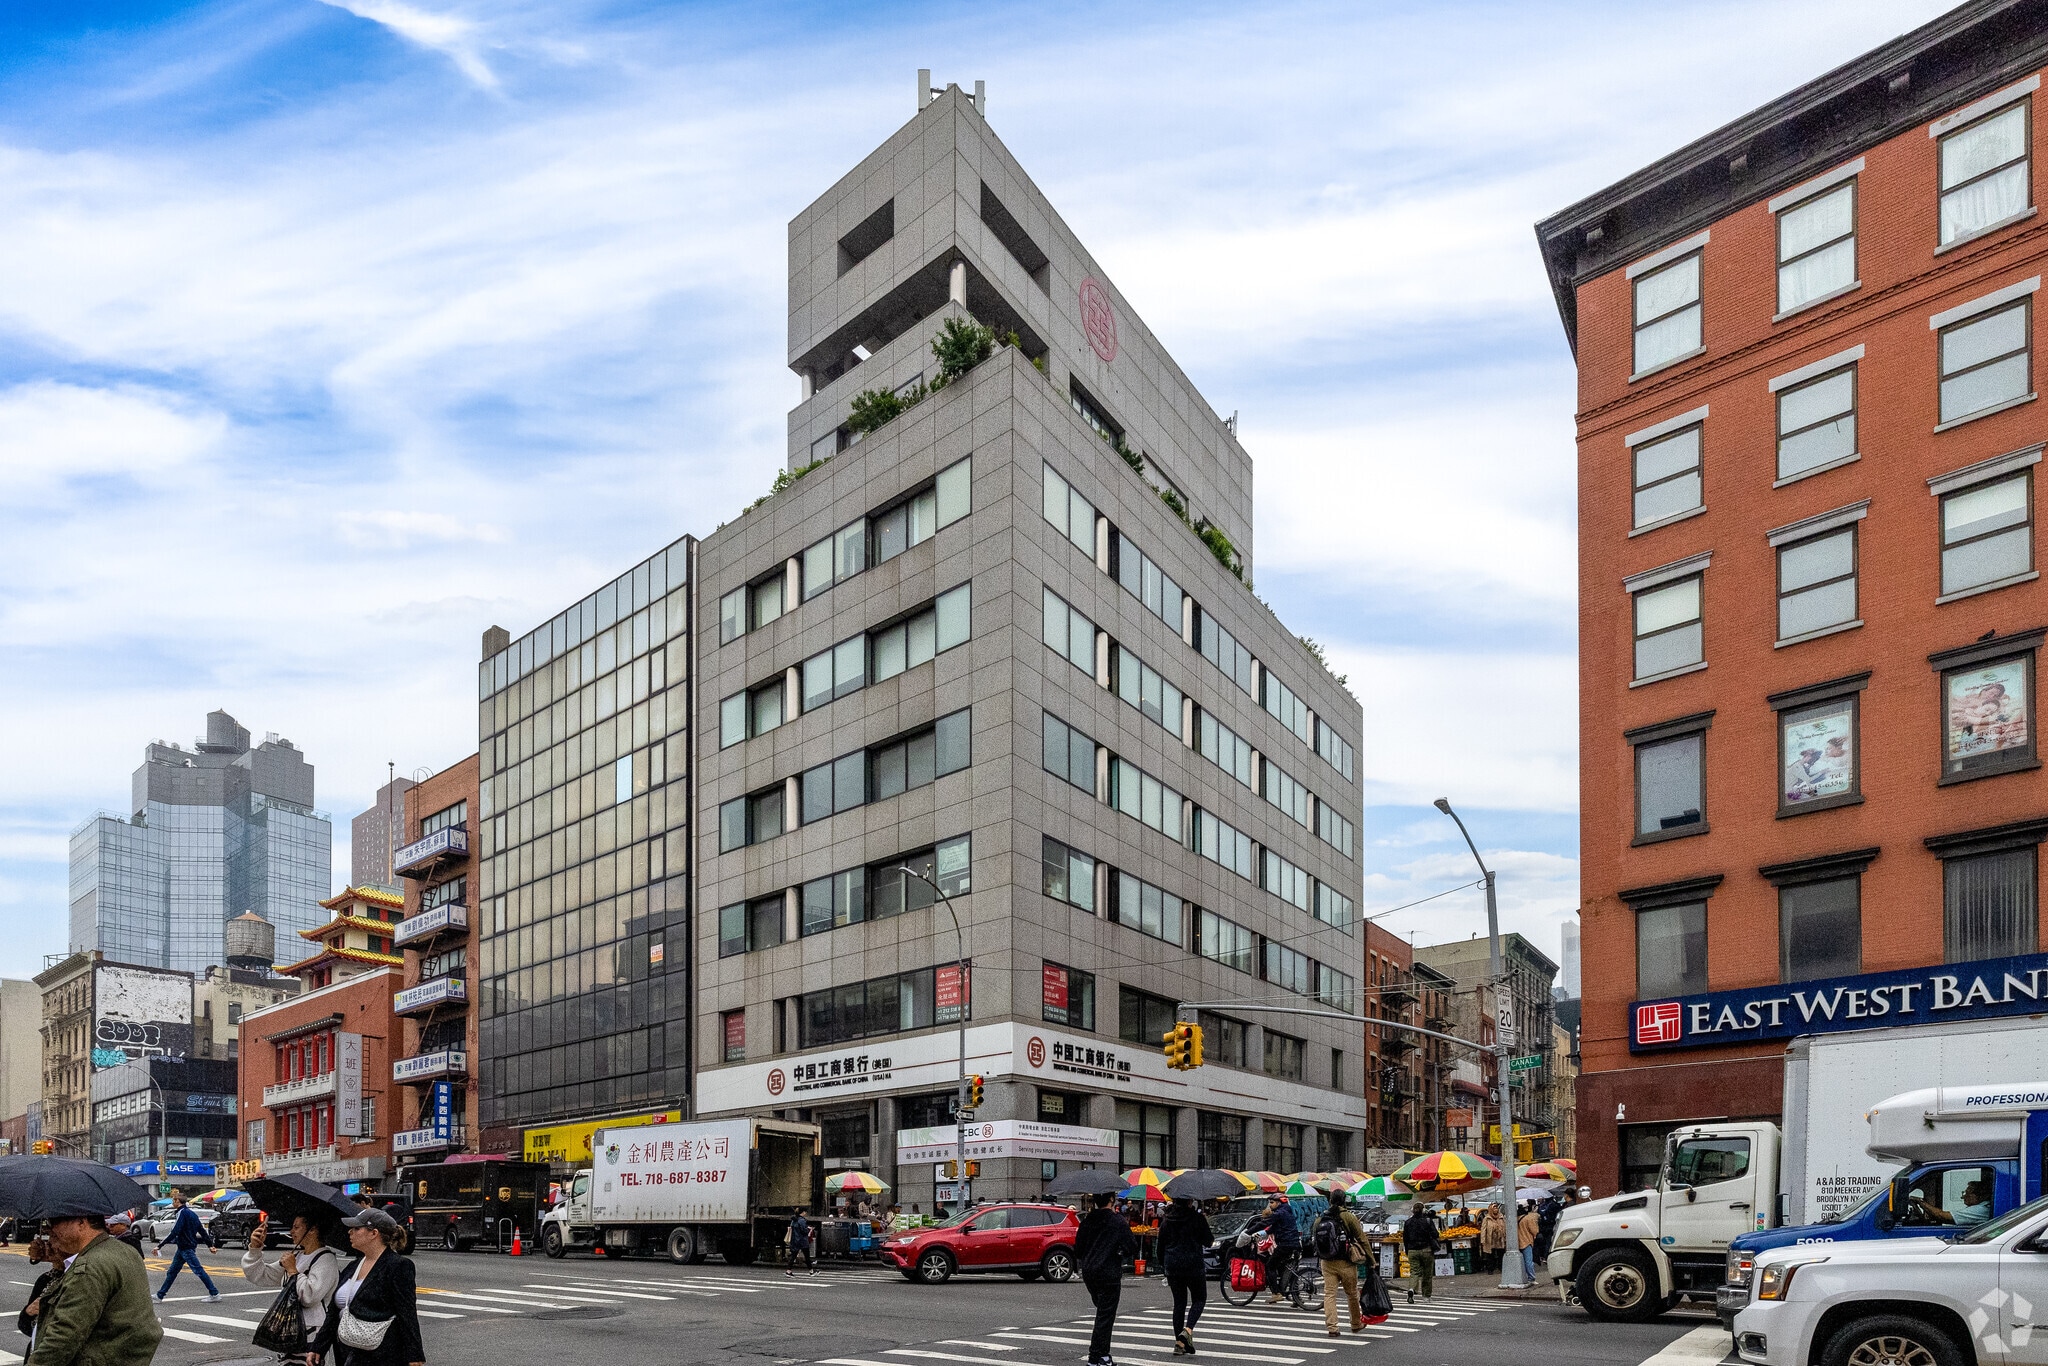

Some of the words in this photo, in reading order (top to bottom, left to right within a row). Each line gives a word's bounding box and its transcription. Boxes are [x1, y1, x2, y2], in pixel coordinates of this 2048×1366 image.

[1497, 987, 1510, 998] SPEED
[1688, 997, 1791, 1036] EAST
[1791, 982, 1922, 1024] WEST
[1930, 969, 2048, 1011] BAN
[1499, 1009, 1512, 1028] 20
[1053, 1041, 1115, 1069] 中国工商银行
[794, 1055, 868, 1081] 中国工商银行
[1511, 1057, 1534, 1068] CANAL
[842, 1078, 852, 1086] BANK
[963, 1127, 980, 1137] CBC
[533, 1134, 551, 1148] NEW
[626, 1136, 729, 1164] 金利農產公司
[964, 1145, 1003, 1155] 你稳健成长
[1018, 1145, 1034, 1154] Serving
[1061, 1149, 1076, 1157] growing
[620, 1173, 642, 1186] TEL:
[645, 1170, 727, 1185] 718-687-8387
[1835, 1177, 1846, 1186] 88
[1847, 1176, 1881, 1186] TRADING
[500, 1191, 511, 1199] ups
[940, 1190, 951, 1200] 415
[1834, 1186, 1861, 1194] MEEKER
[1816, 1195, 1849, 1203] BROOKLYN
